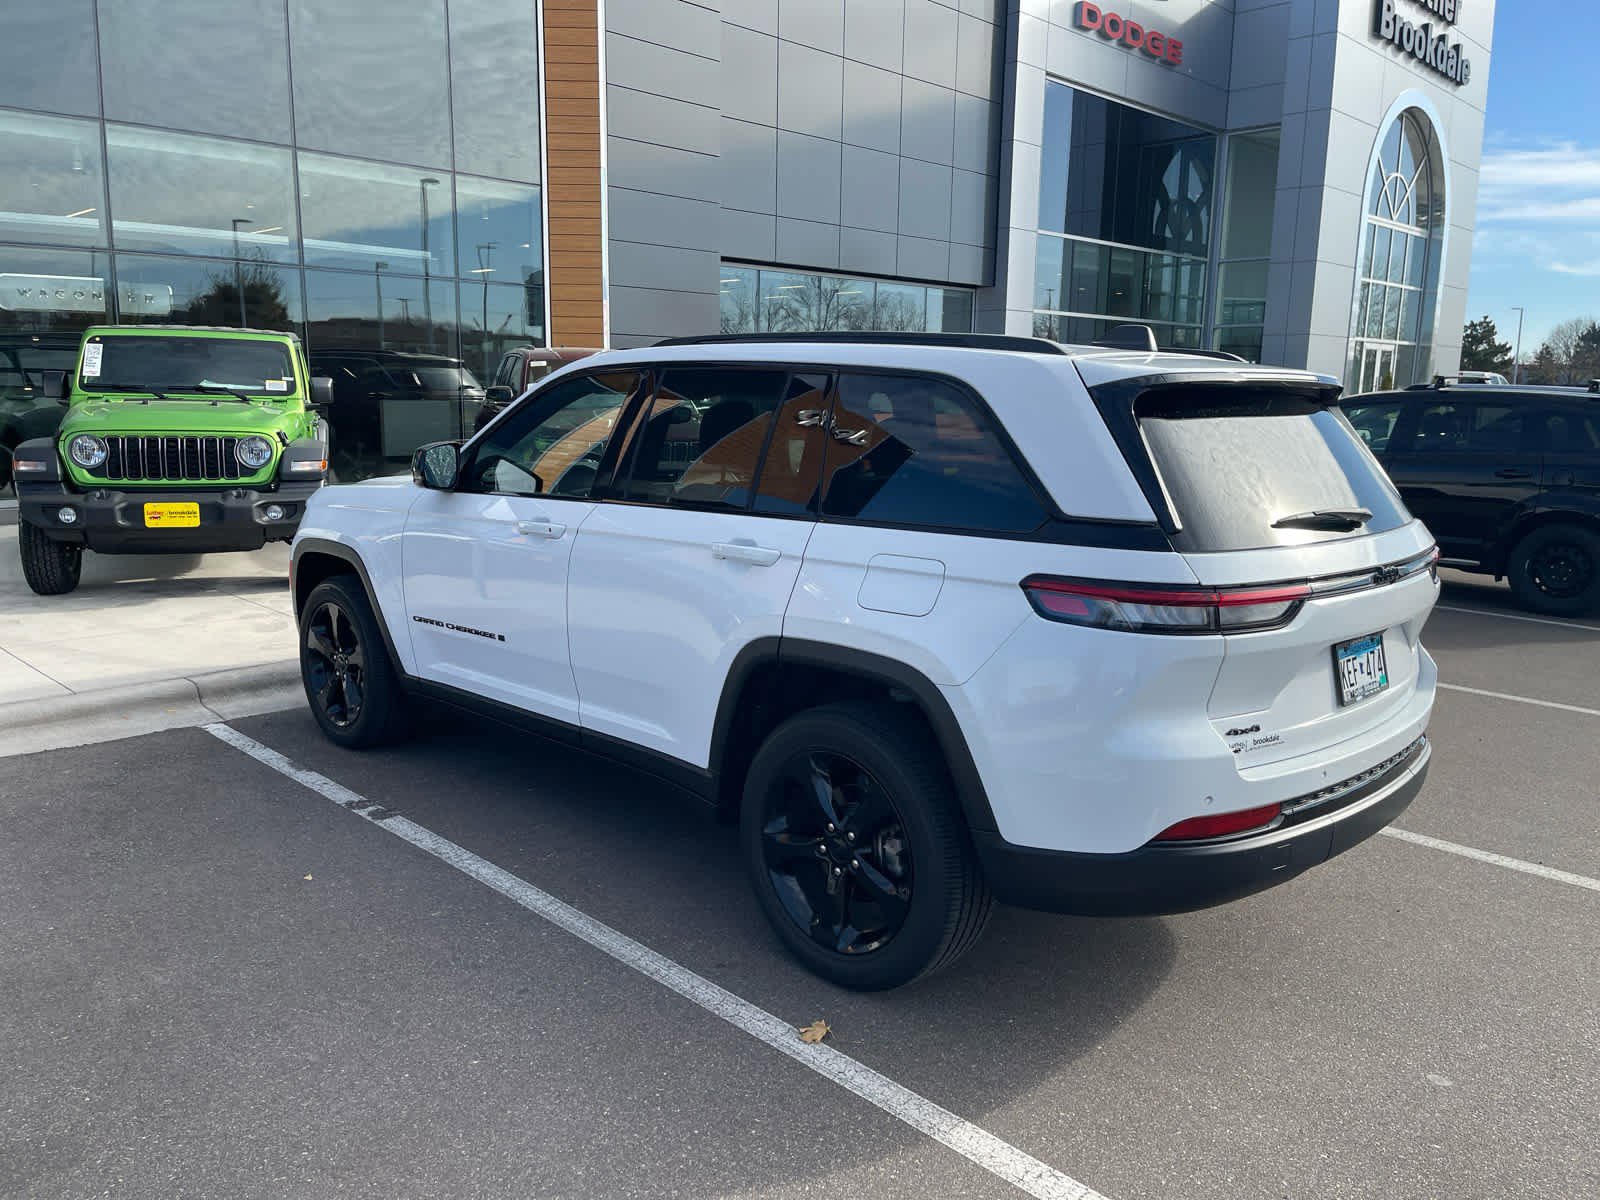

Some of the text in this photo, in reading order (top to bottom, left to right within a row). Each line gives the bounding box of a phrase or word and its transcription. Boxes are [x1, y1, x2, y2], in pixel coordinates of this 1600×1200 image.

[1075, 1, 1183, 65] DODGE
[1375, 0, 1471, 85] Brookdale
[16, 287, 155, 304] WAGONER
[412, 615, 497, 640] GRAND CHEROKEE
[1339, 656, 1358, 691] KEF
[1366, 648, 1386, 681] 474
